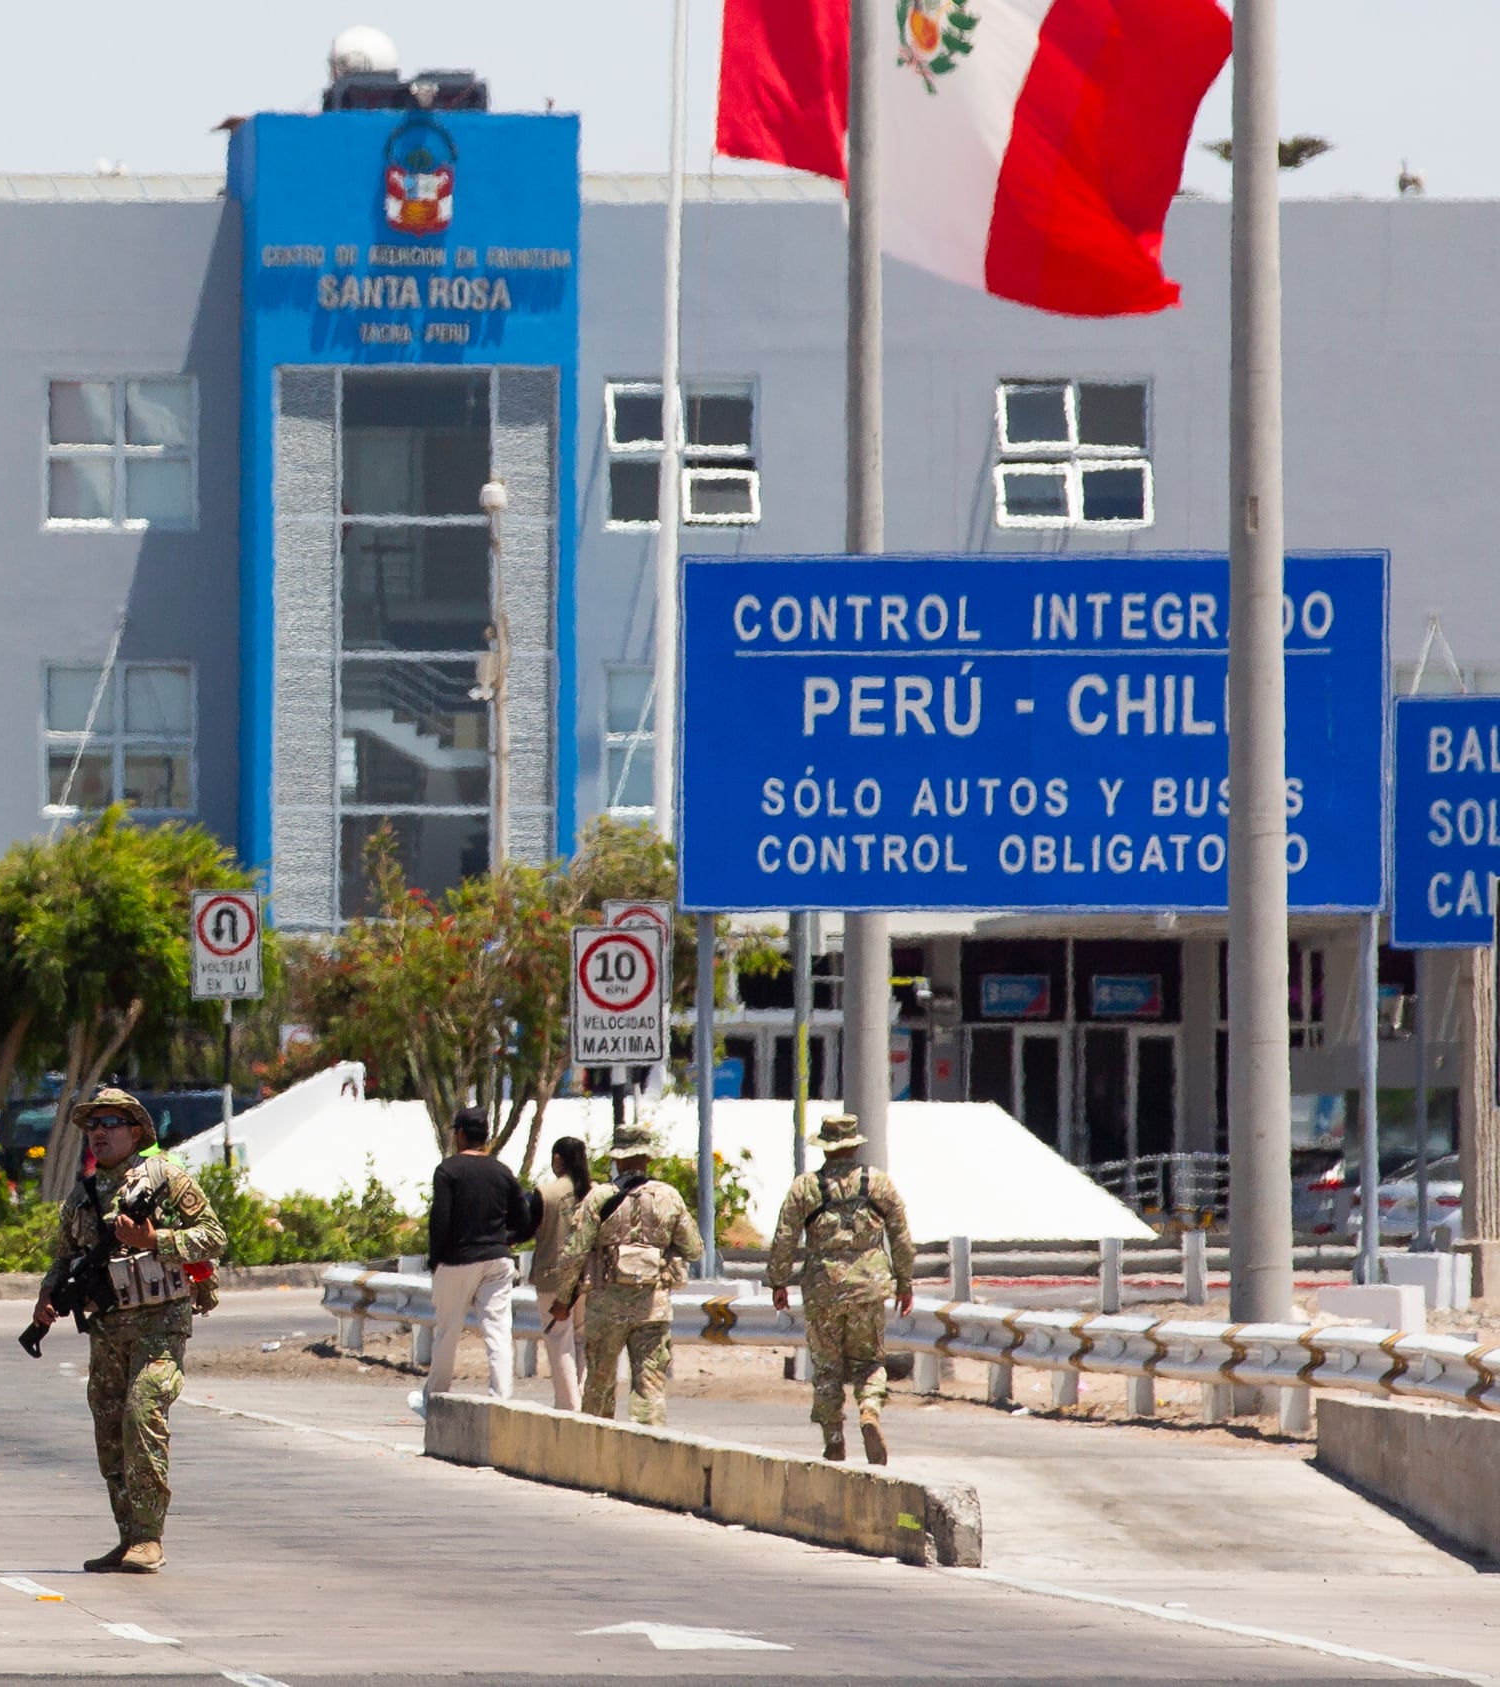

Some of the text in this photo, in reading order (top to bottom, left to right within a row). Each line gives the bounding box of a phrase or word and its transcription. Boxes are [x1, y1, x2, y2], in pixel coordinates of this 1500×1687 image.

[318, 275, 512, 311] SANTA ROSA
[733, 591, 1334, 642] CONTROL INTEGRO
[803, 661, 982, 737] PERÚ
[1068, 673, 1230, 736] CHIL
[761, 765, 882, 817] SÓLO
[912, 777, 1068, 817] AUTOS
[1099, 777, 1124, 817] Y
[757, 833, 1308, 874] CONTROL OBLIGATOO
[595, 950, 636, 982] 10
[583, 1015, 656, 1030] VELOCIDAD
[583, 1036, 656, 1054] MAXIMA
